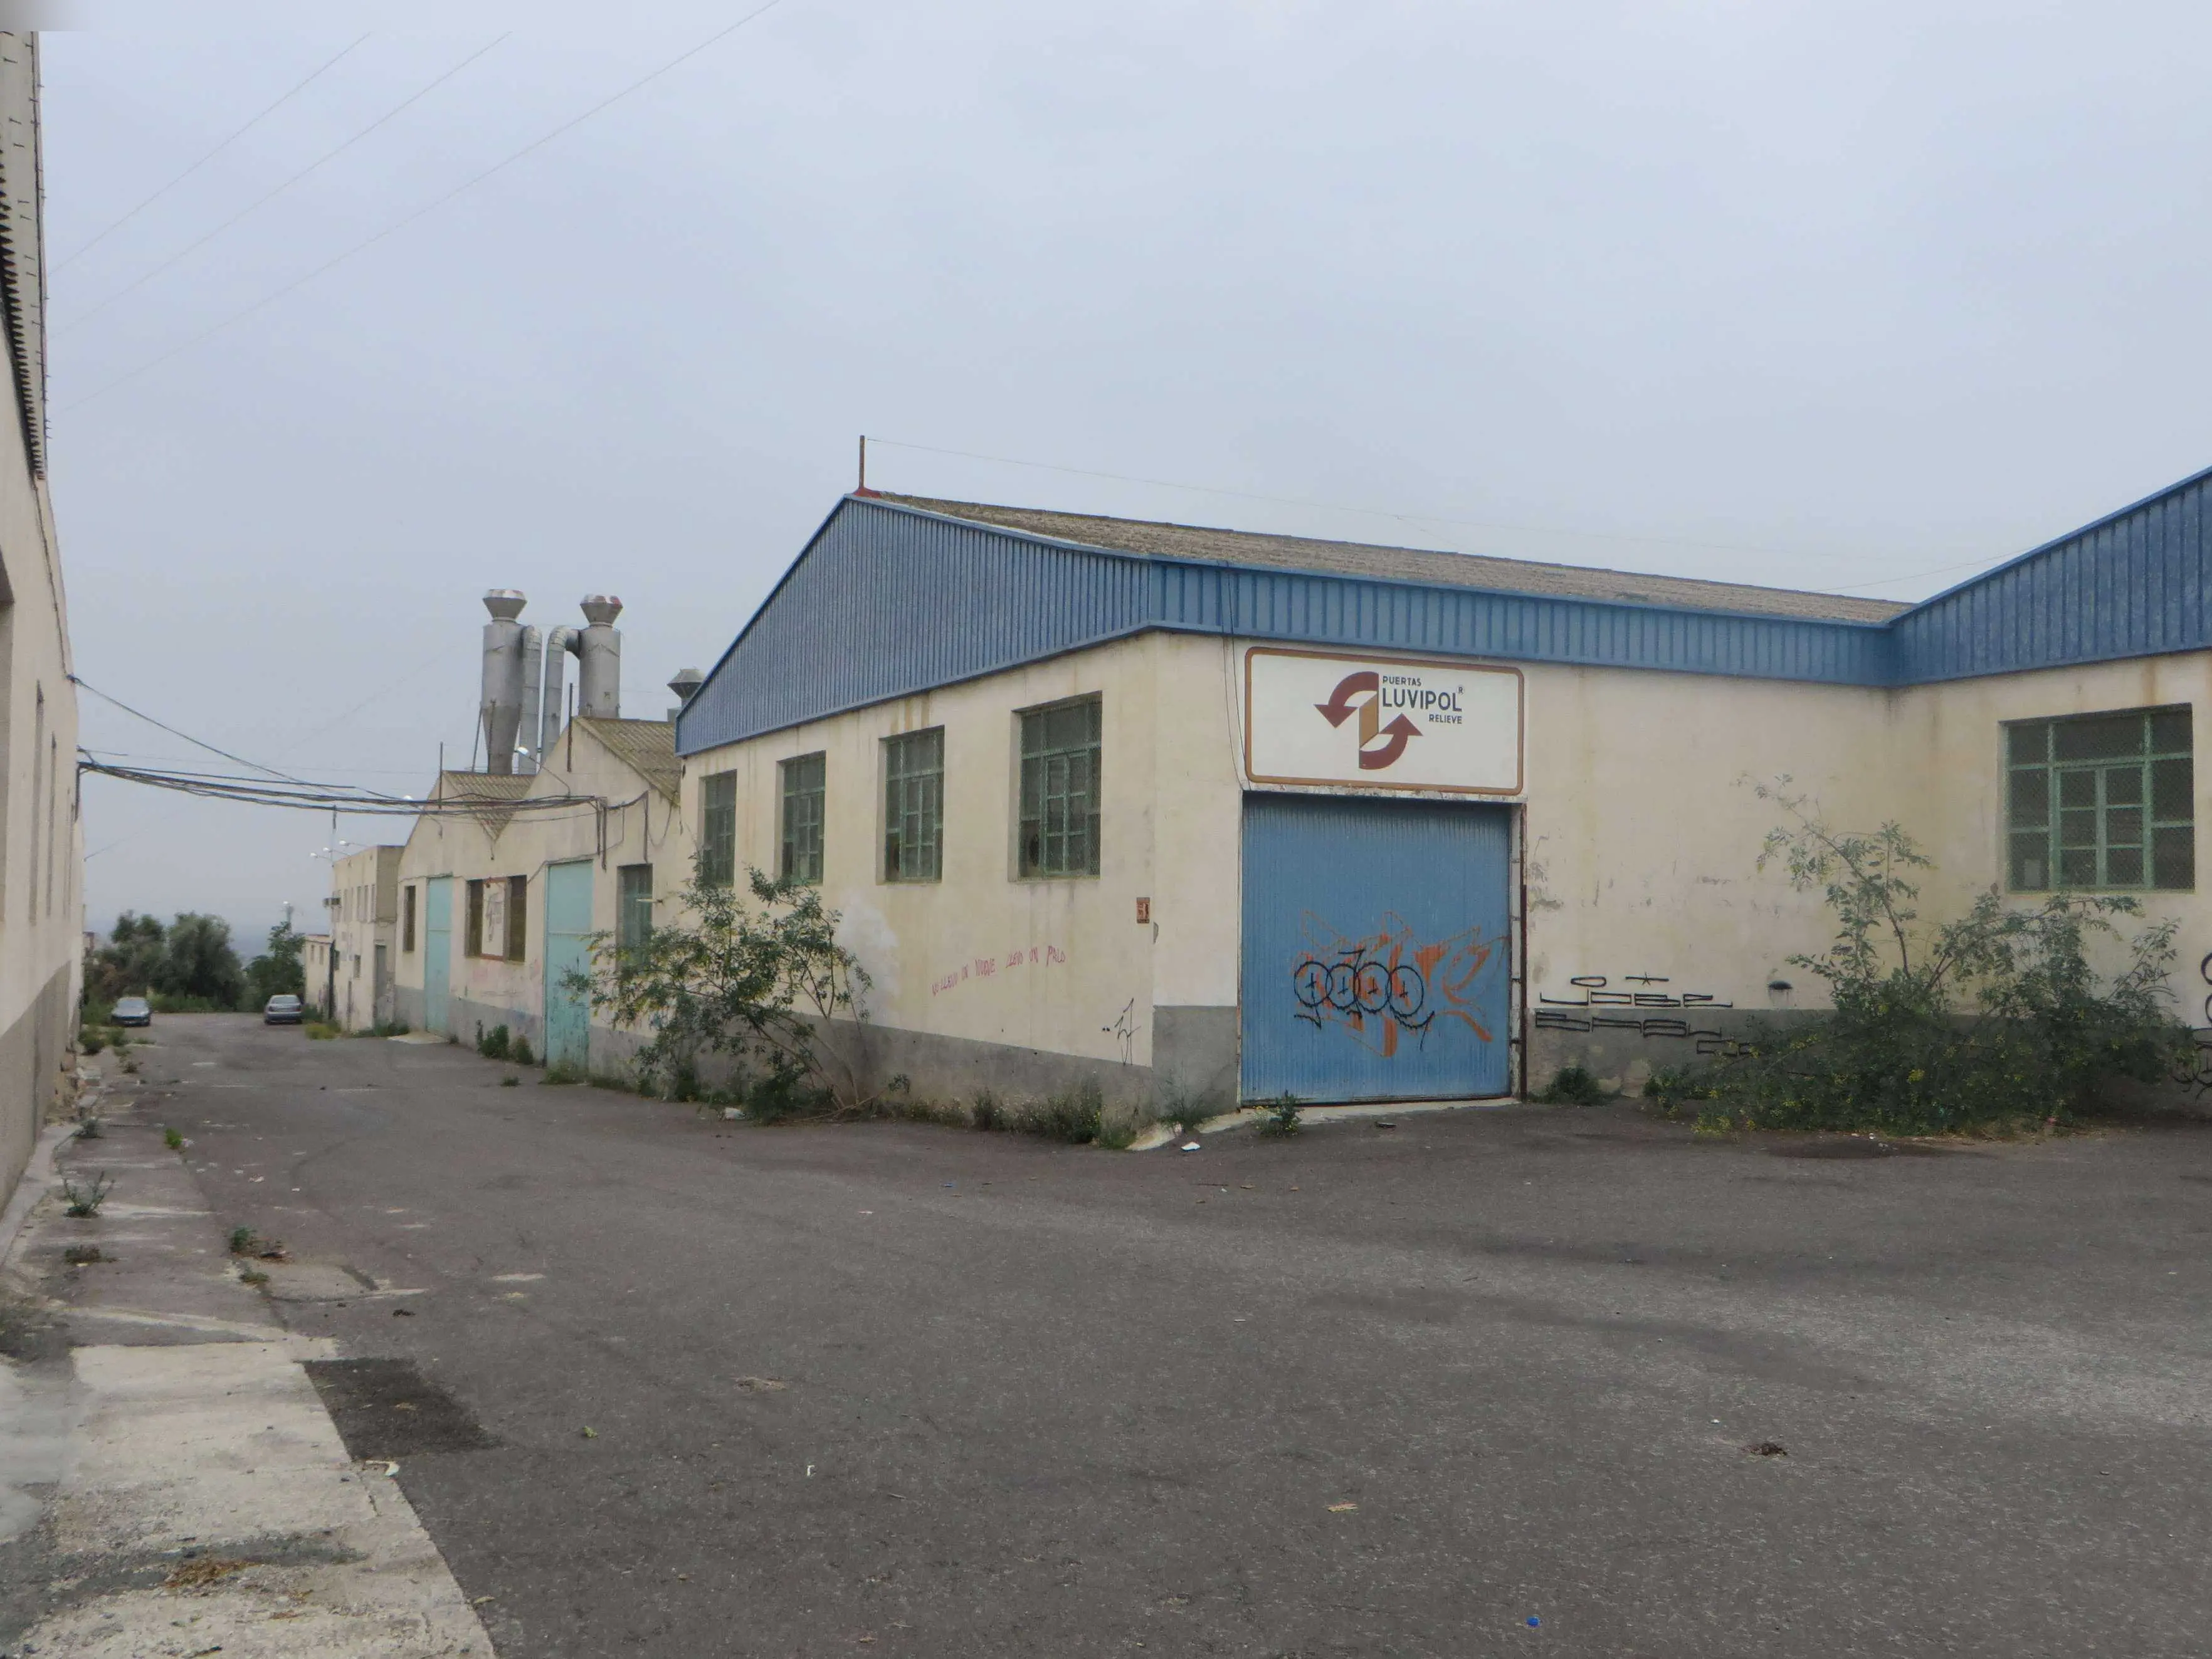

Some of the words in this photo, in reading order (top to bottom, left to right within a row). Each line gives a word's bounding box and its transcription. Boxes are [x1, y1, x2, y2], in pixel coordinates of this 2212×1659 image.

[1382, 675, 1421, 687] PUERTAS
[1382, 687, 1462, 712] LUVIPOL
[1429, 714, 1462, 724] RELIEVE
